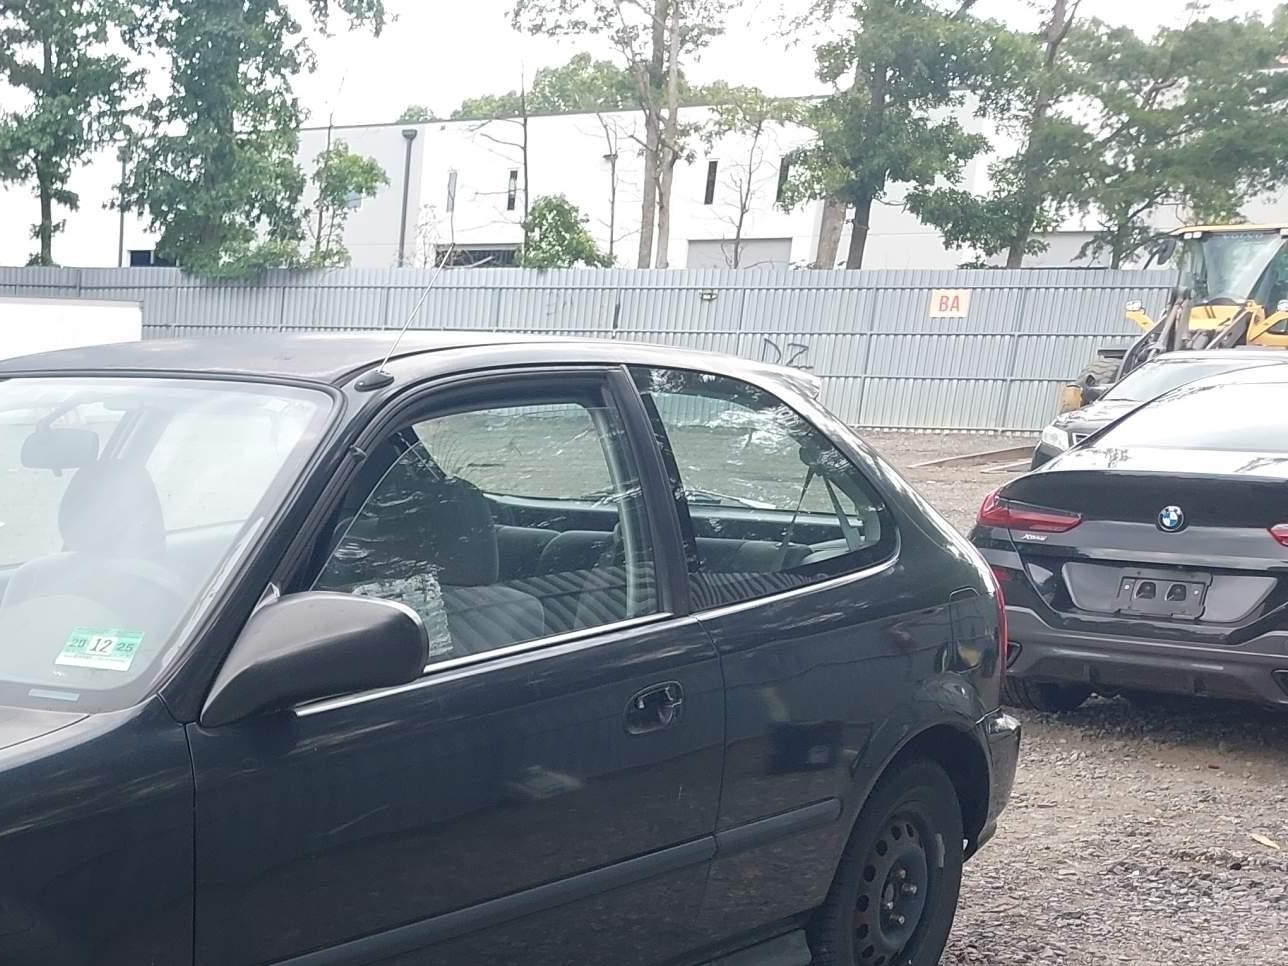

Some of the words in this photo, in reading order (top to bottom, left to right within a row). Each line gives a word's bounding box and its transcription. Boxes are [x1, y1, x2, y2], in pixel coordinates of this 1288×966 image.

[939, 295, 960, 312] BA
[89, 638, 113, 653] 12
[116, 642, 135, 652] 25
